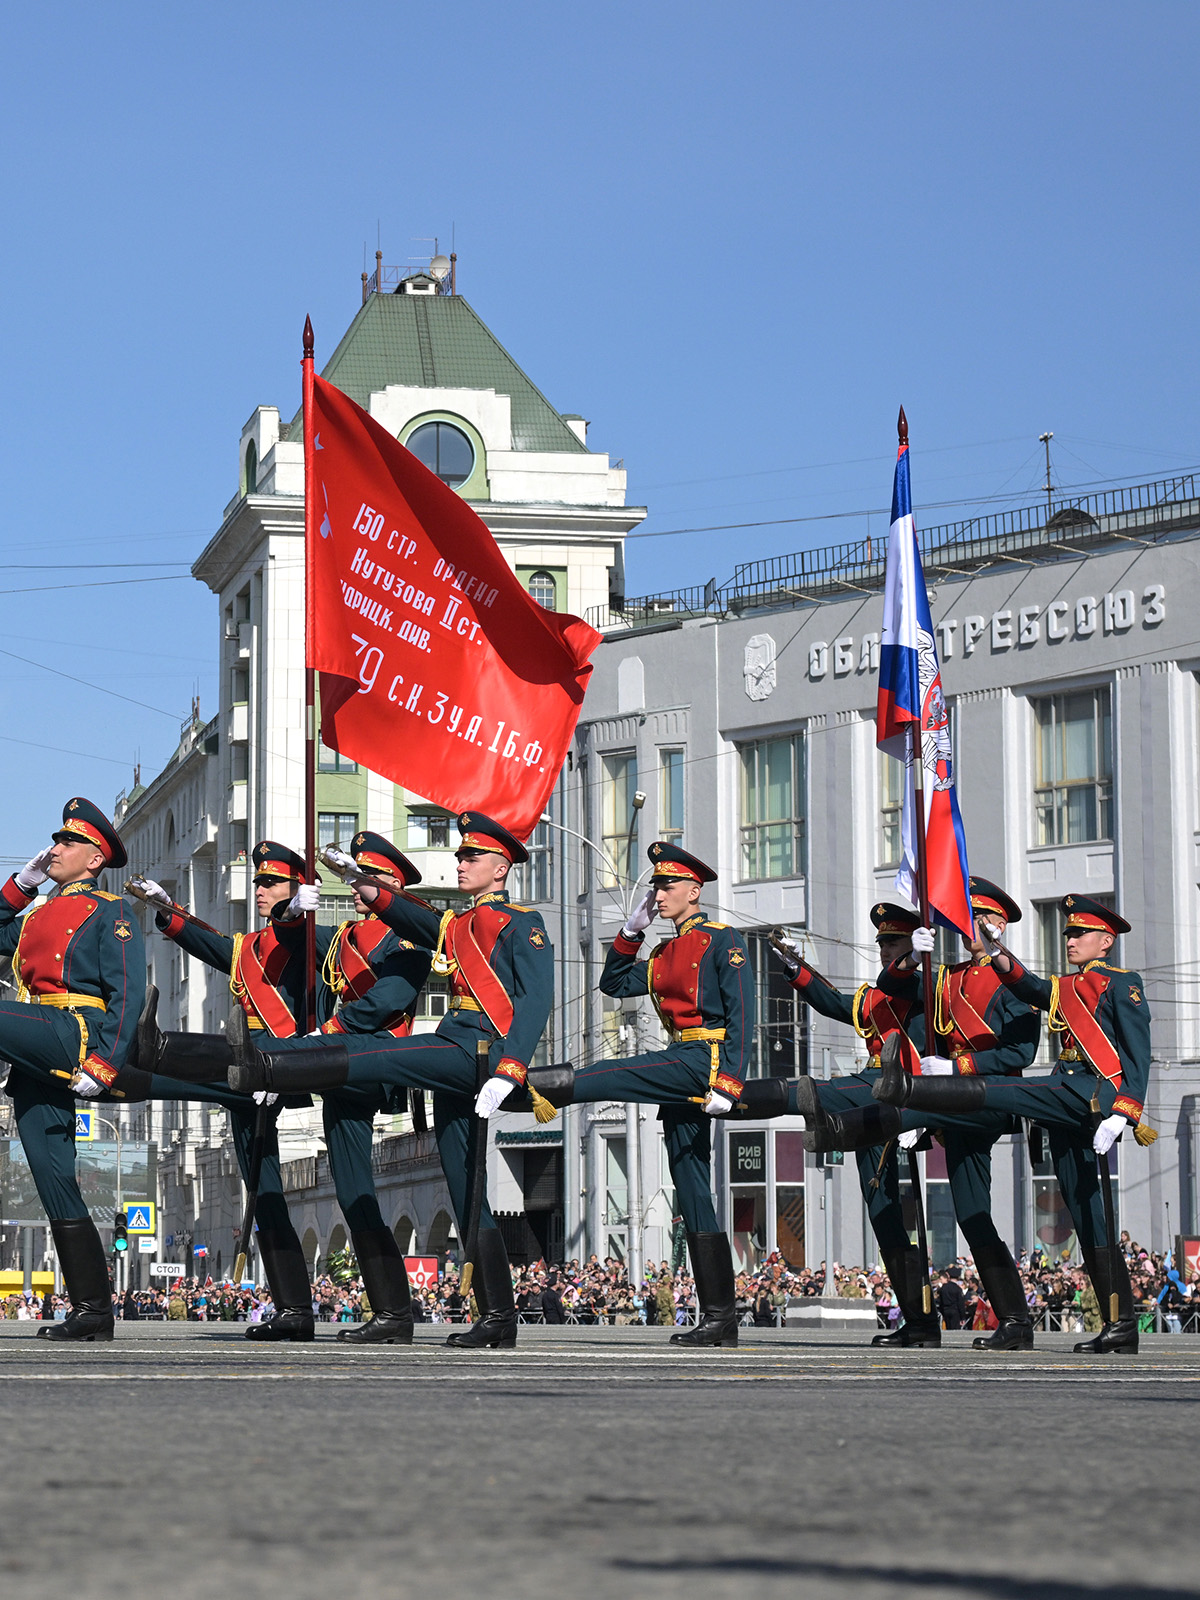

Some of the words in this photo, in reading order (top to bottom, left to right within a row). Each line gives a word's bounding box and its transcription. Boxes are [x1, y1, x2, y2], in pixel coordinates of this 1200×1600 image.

[352, 502, 385, 541] 150
[351, 633, 385, 694] 79
[738, 1146, 762, 1157] РИВ
[738, 1158, 762, 1170] ГОШ
[156, 1266, 180, 1274] СТОП
[416, 1272, 426, 1289] 9
